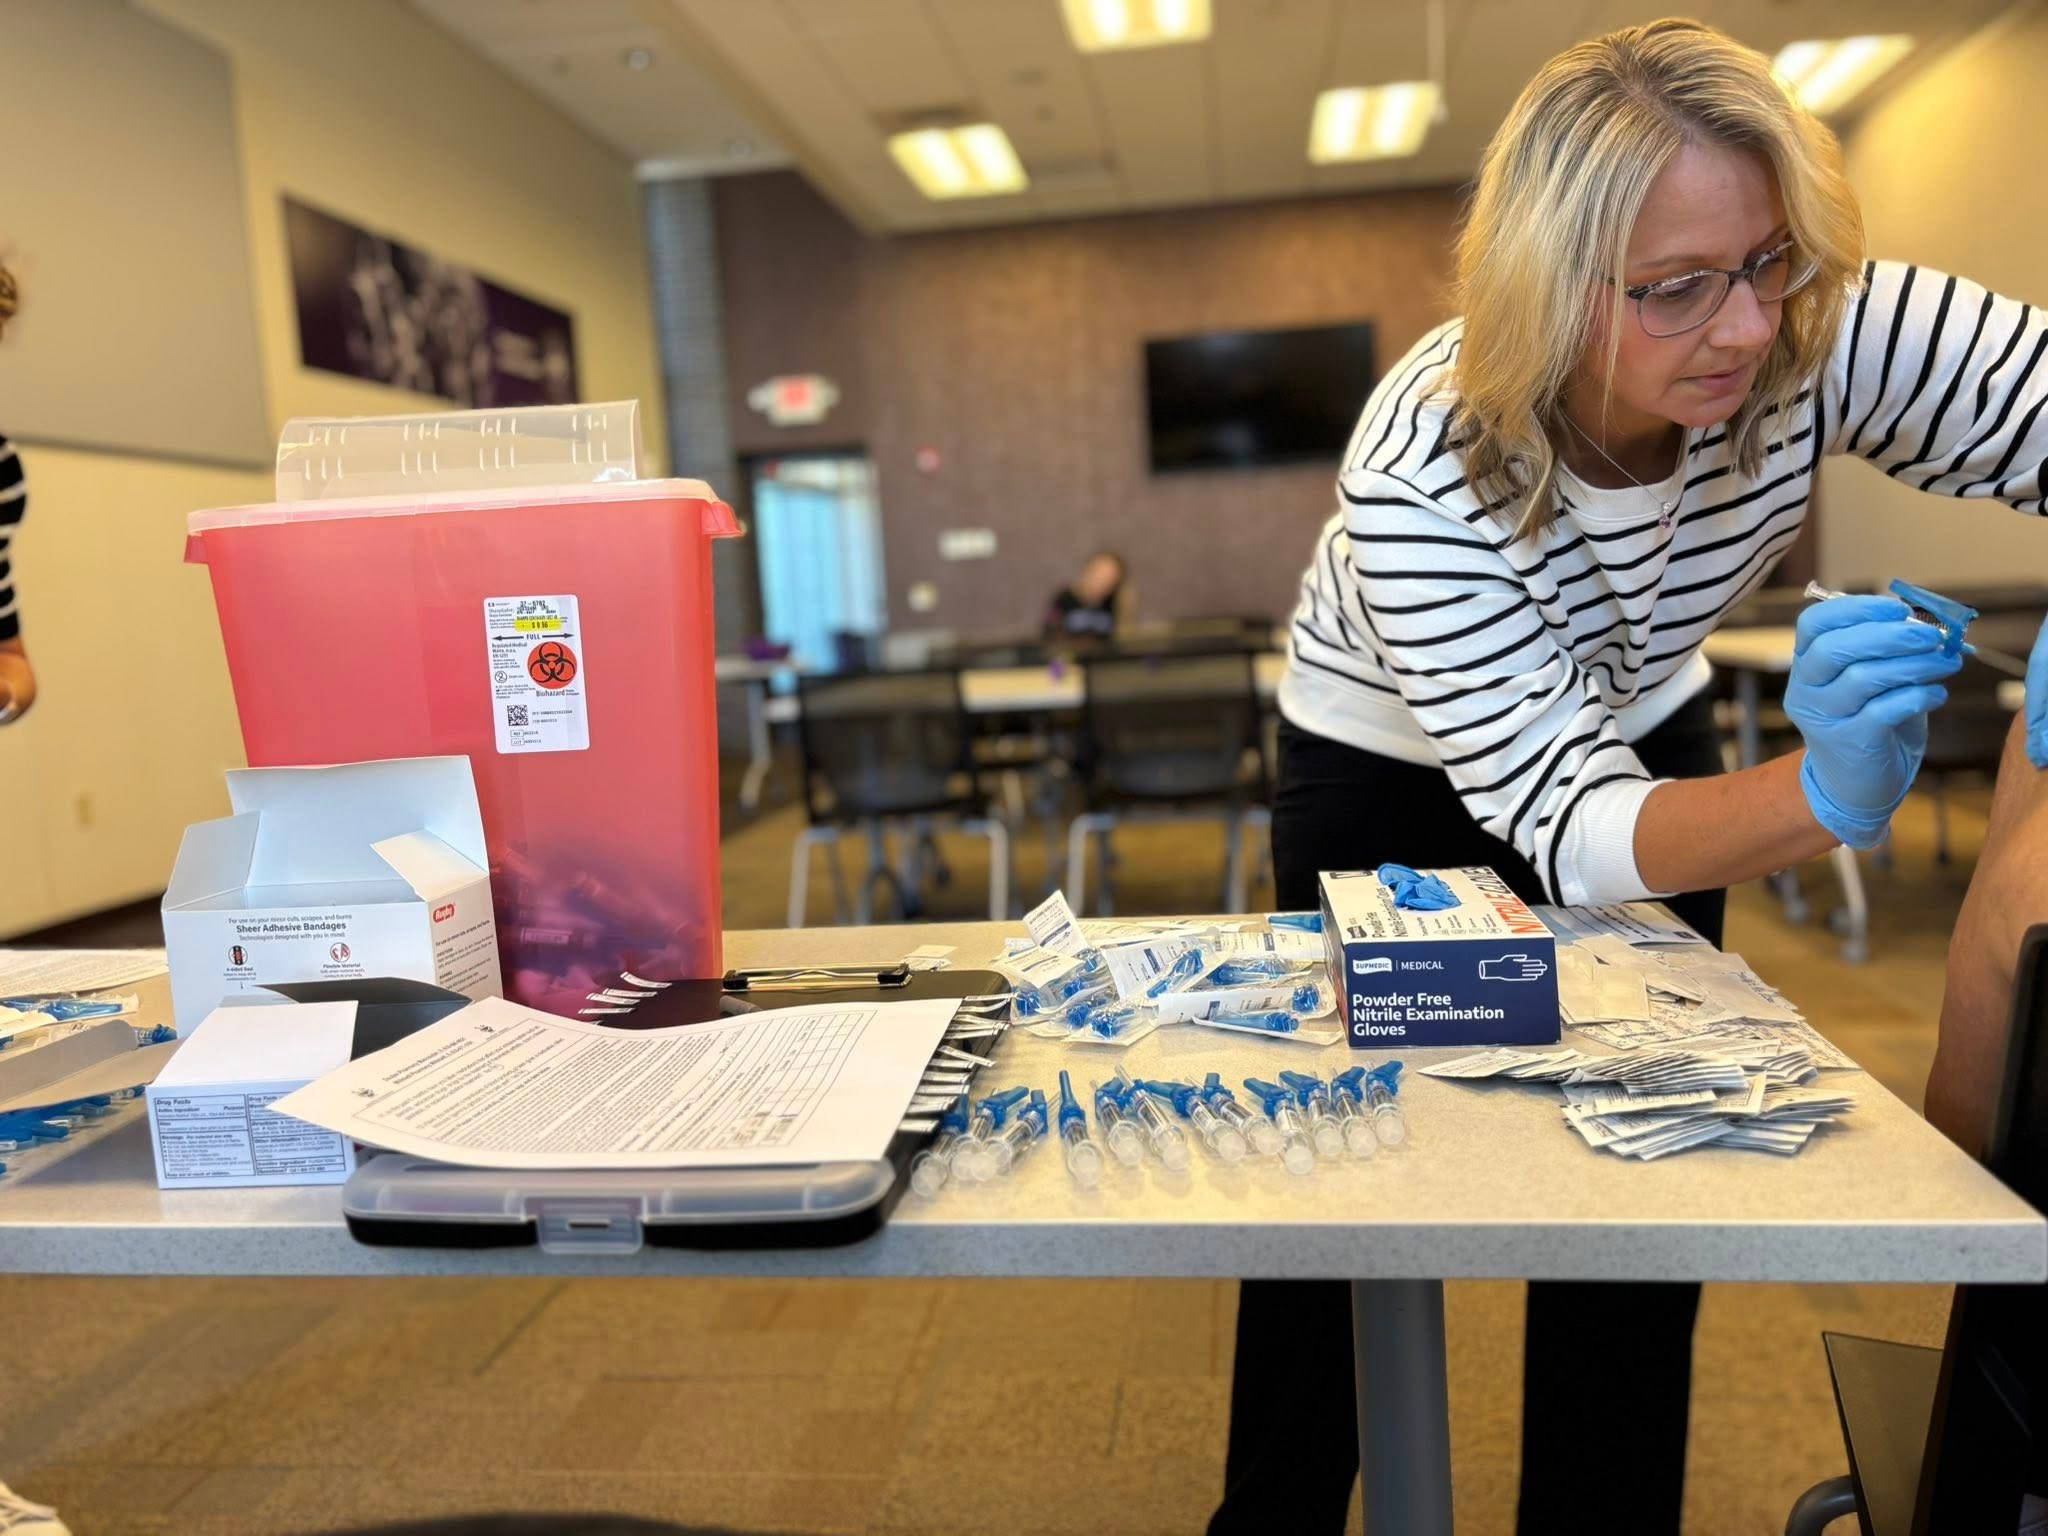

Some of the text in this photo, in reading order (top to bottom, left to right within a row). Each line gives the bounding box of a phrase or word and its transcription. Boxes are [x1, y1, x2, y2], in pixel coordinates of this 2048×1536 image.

[1484, 893, 1549, 934] NITRILE
[236, 921, 347, 934] Sheer Adhesive Bandages
[1355, 961, 1445, 970] SUPMEDIC MEDICAL
[1352, 992, 1452, 1007] Powder Free
[1353, 1006, 1505, 1021] Nitrile Examination
[1353, 1022, 1407, 1036] Gloves
